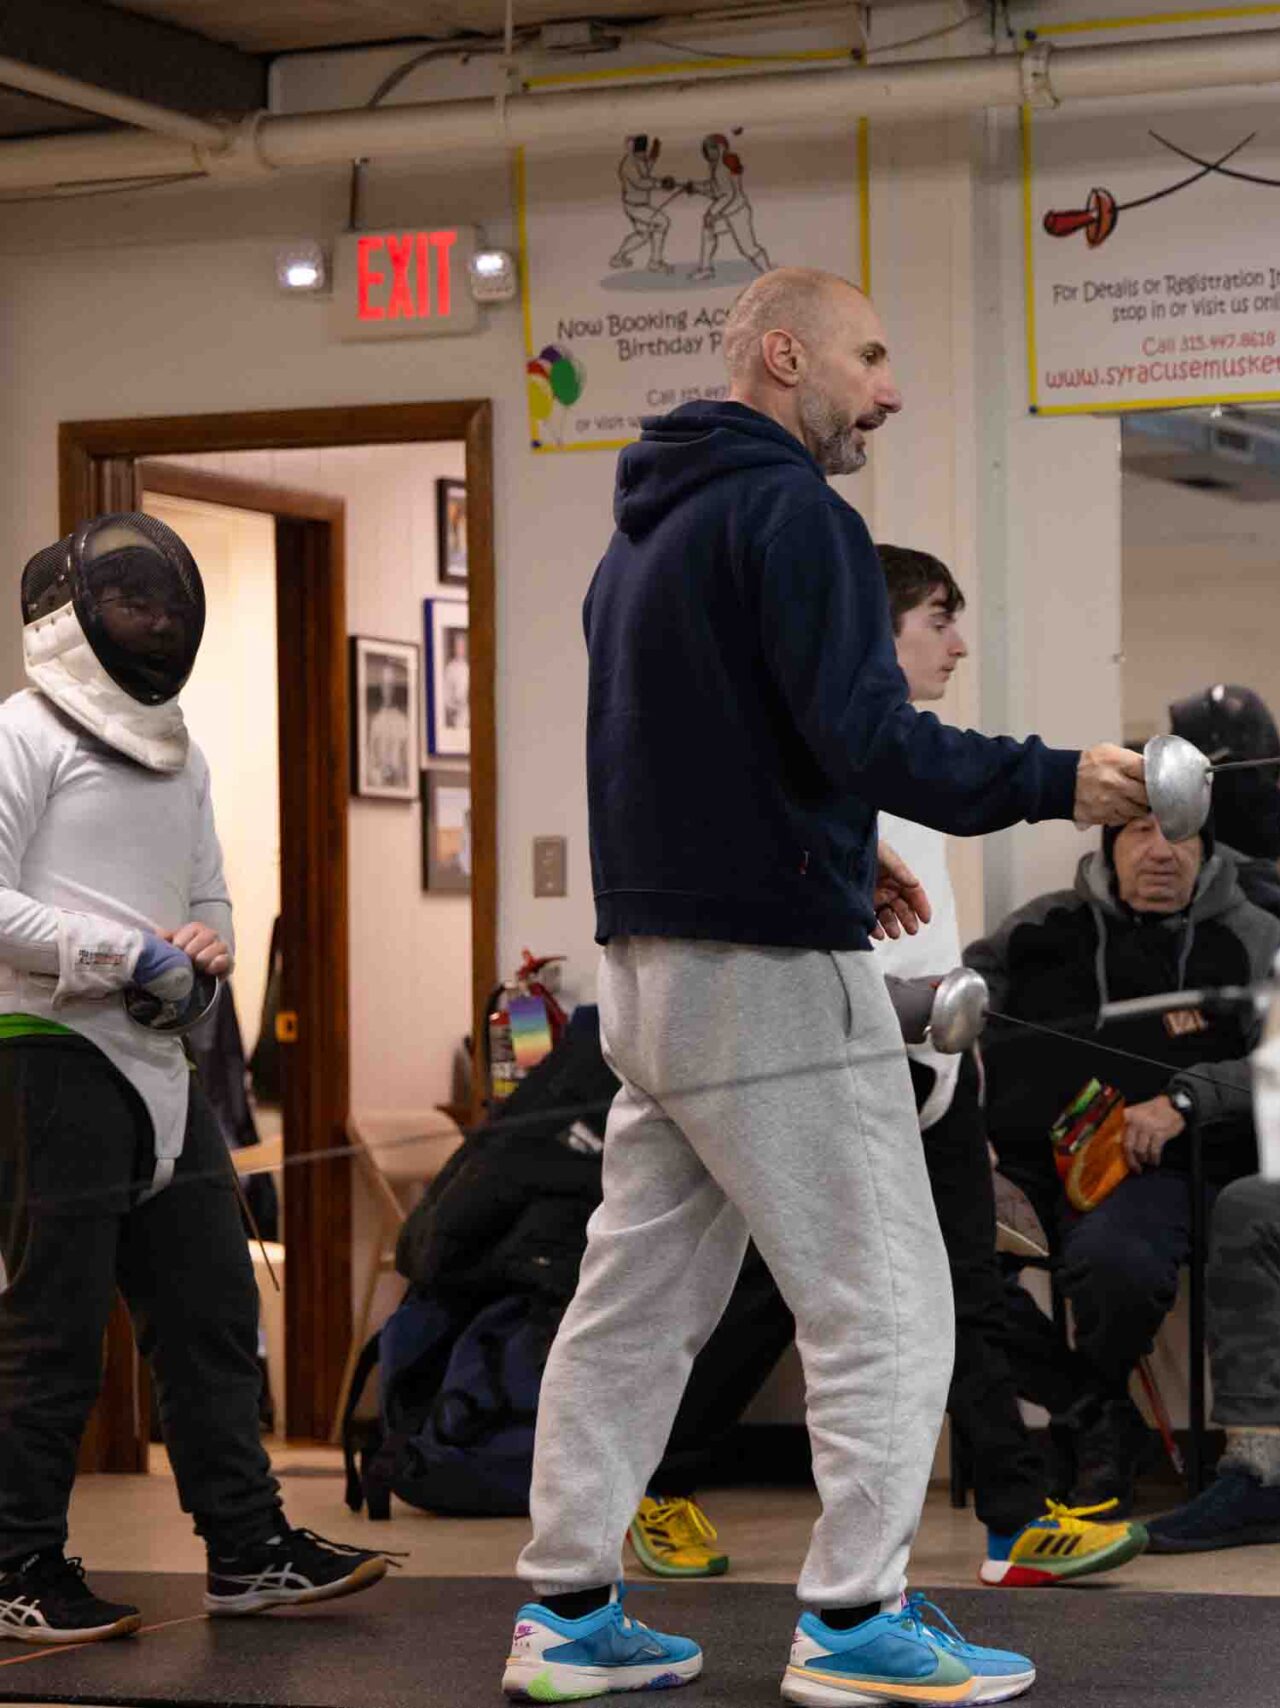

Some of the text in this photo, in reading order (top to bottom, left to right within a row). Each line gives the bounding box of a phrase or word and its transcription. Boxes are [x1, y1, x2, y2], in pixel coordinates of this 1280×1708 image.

[357, 230, 456, 320] EXIT
[1053, 283, 1078, 305] For
[1083, 277, 1140, 303] Details
[1143, 279, 1161, 295] or
[1164, 269, 1264, 296] Registration
[1112, 304, 1147, 323] stop
[1152, 301, 1166, 318] in
[1170, 302, 1187, 317] or
[1193, 297, 1227, 316] visit
[1231, 297, 1250, 314] us
[557, 318, 603, 340] Now
[608, 309, 689, 337] Booking
[617, 335, 704, 361] Birthday
[1142, 336, 1176, 357] Call
